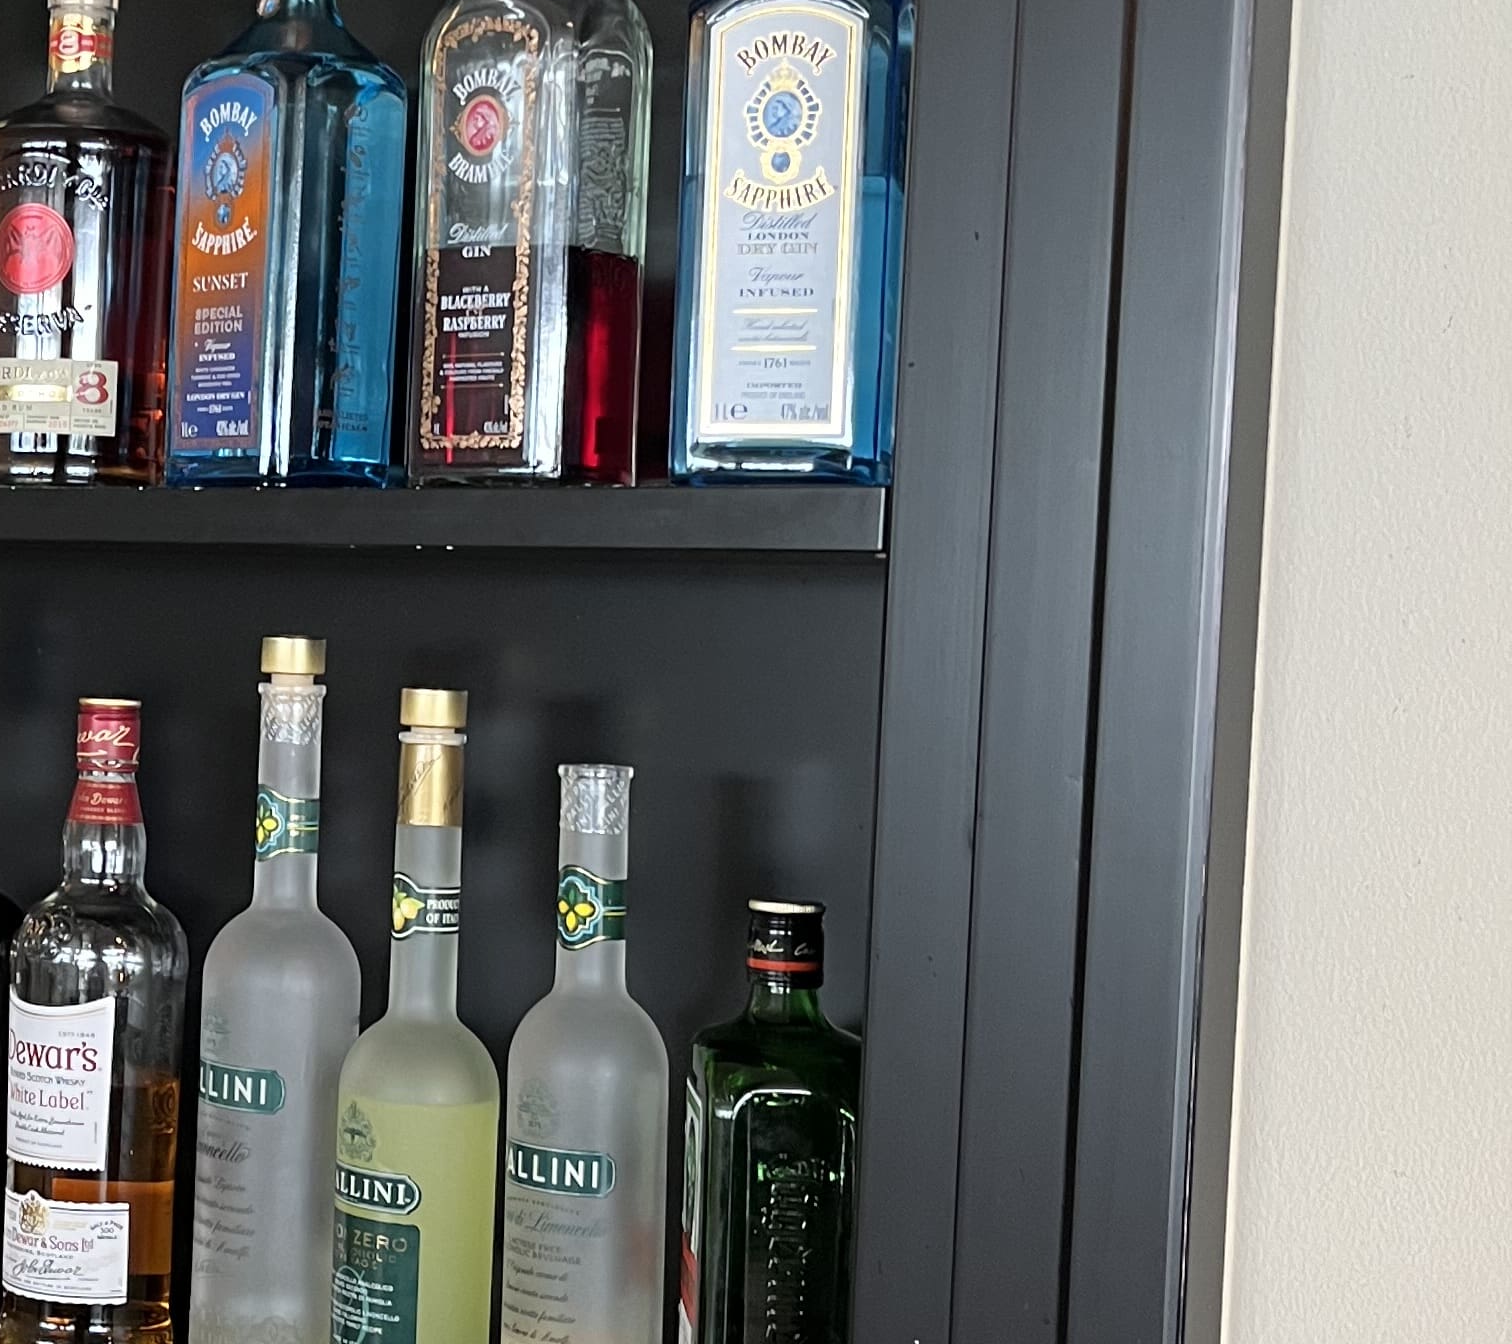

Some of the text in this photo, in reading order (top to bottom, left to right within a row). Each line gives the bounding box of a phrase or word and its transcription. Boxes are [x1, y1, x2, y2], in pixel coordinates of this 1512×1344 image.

[736, 31, 836, 74] BOMBAY
[452, 68, 521, 106] BOMBAY
[200, 102, 258, 142] BOMBAY
[448, 149, 514, 184] BRAMBLE
[726, 170, 831, 210] SAPPHIRE
[740, 211, 818, 231] Distilled
[192, 216, 256, 256] SAPPHIRE
[748, 232, 809, 241] LONDON
[462, 244, 491, 258] GIN
[737, 242, 818, 255] DRY GIN
[193, 272, 249, 292] SUNSET
[748, 266, 805, 284] Vapour
[440, 293, 511, 311] BLACKBERRY
[740, 288, 814, 297] INFUSED
[195, 305, 243, 321] SPECIAL
[194, 320, 243, 335] EDITION
[443, 315, 506, 332] RASPBERRY
[199, 353, 236, 362] INFUSED
[764, 358, 787, 368] 1761
[75, 370, 109, 405] 8
[427, 899, 460, 911] PRODUC
[426, 913, 440, 924] OF
[9, 1028, 98, 1072] Dewar's
[26, 1072, 86, 1087] SCOTCH WHISKY
[199, 1065, 266, 1105] LLINI
[10, 1081, 84, 1110] White Label
[508, 1147, 599, 1189] ALLINI
[336, 1169, 406, 1205] LLINI
[12, 1227, 94, 1252] Dewar & Sons Ltd
